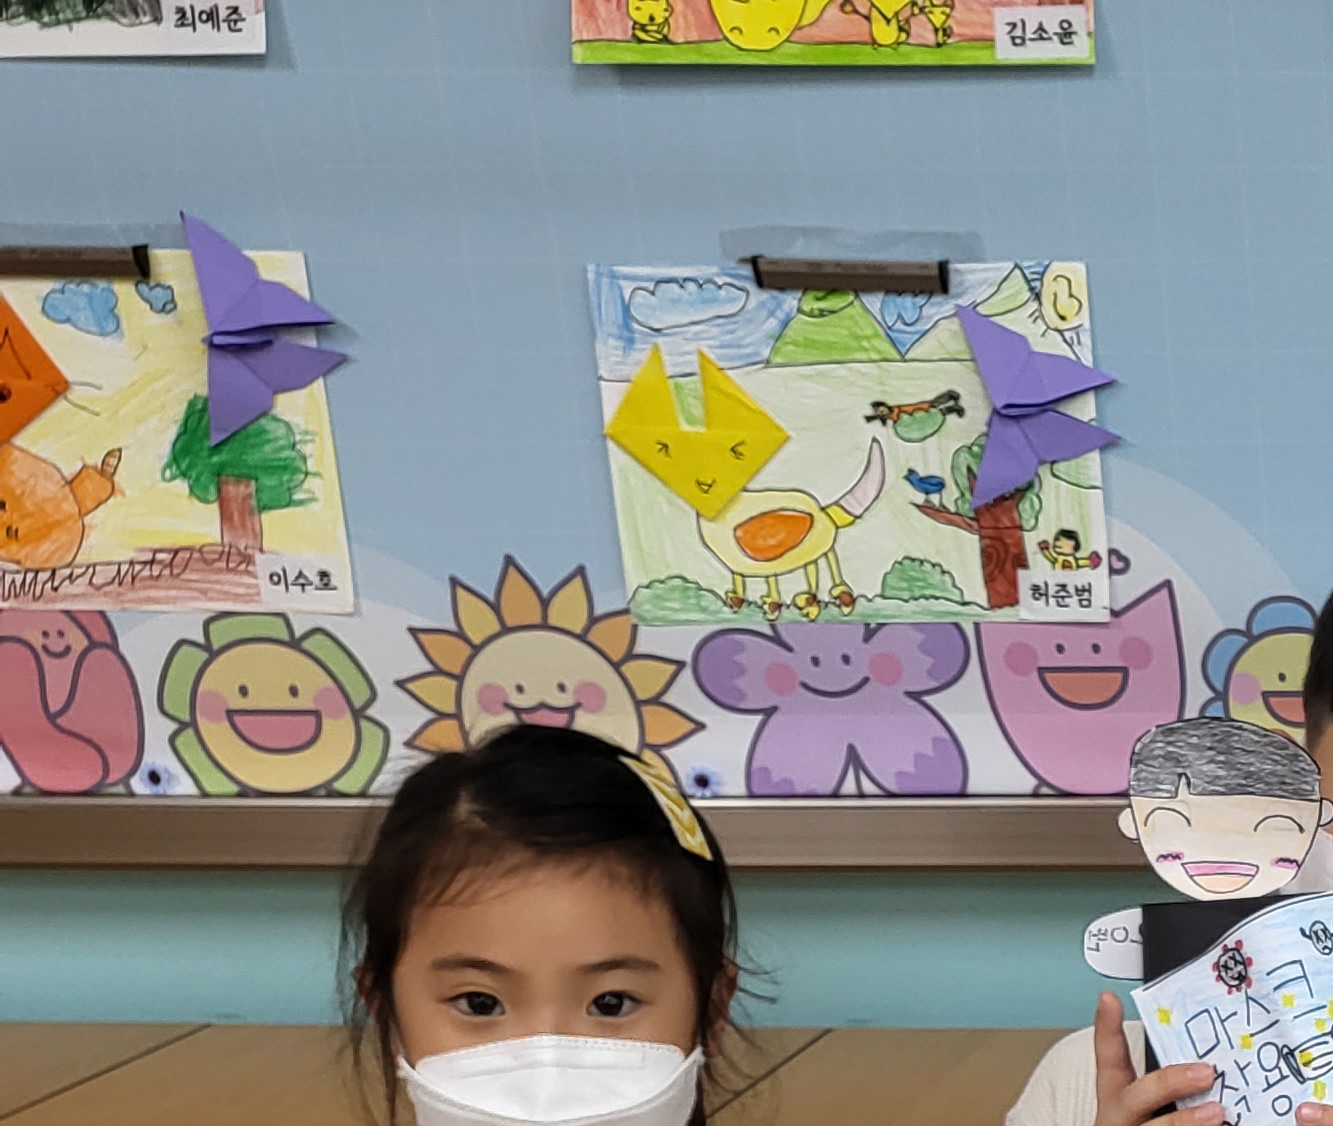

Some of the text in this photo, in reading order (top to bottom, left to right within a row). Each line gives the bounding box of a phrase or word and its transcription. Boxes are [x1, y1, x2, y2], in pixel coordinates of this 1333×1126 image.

[174, 3, 247, 33] 최예준
[1004, 18, 1078, 47] 김소윤
[268, 565, 338, 594] 이수호
[1029, 580, 1092, 609] 허준범
[1184, 958, 1328, 1060] 마스크
